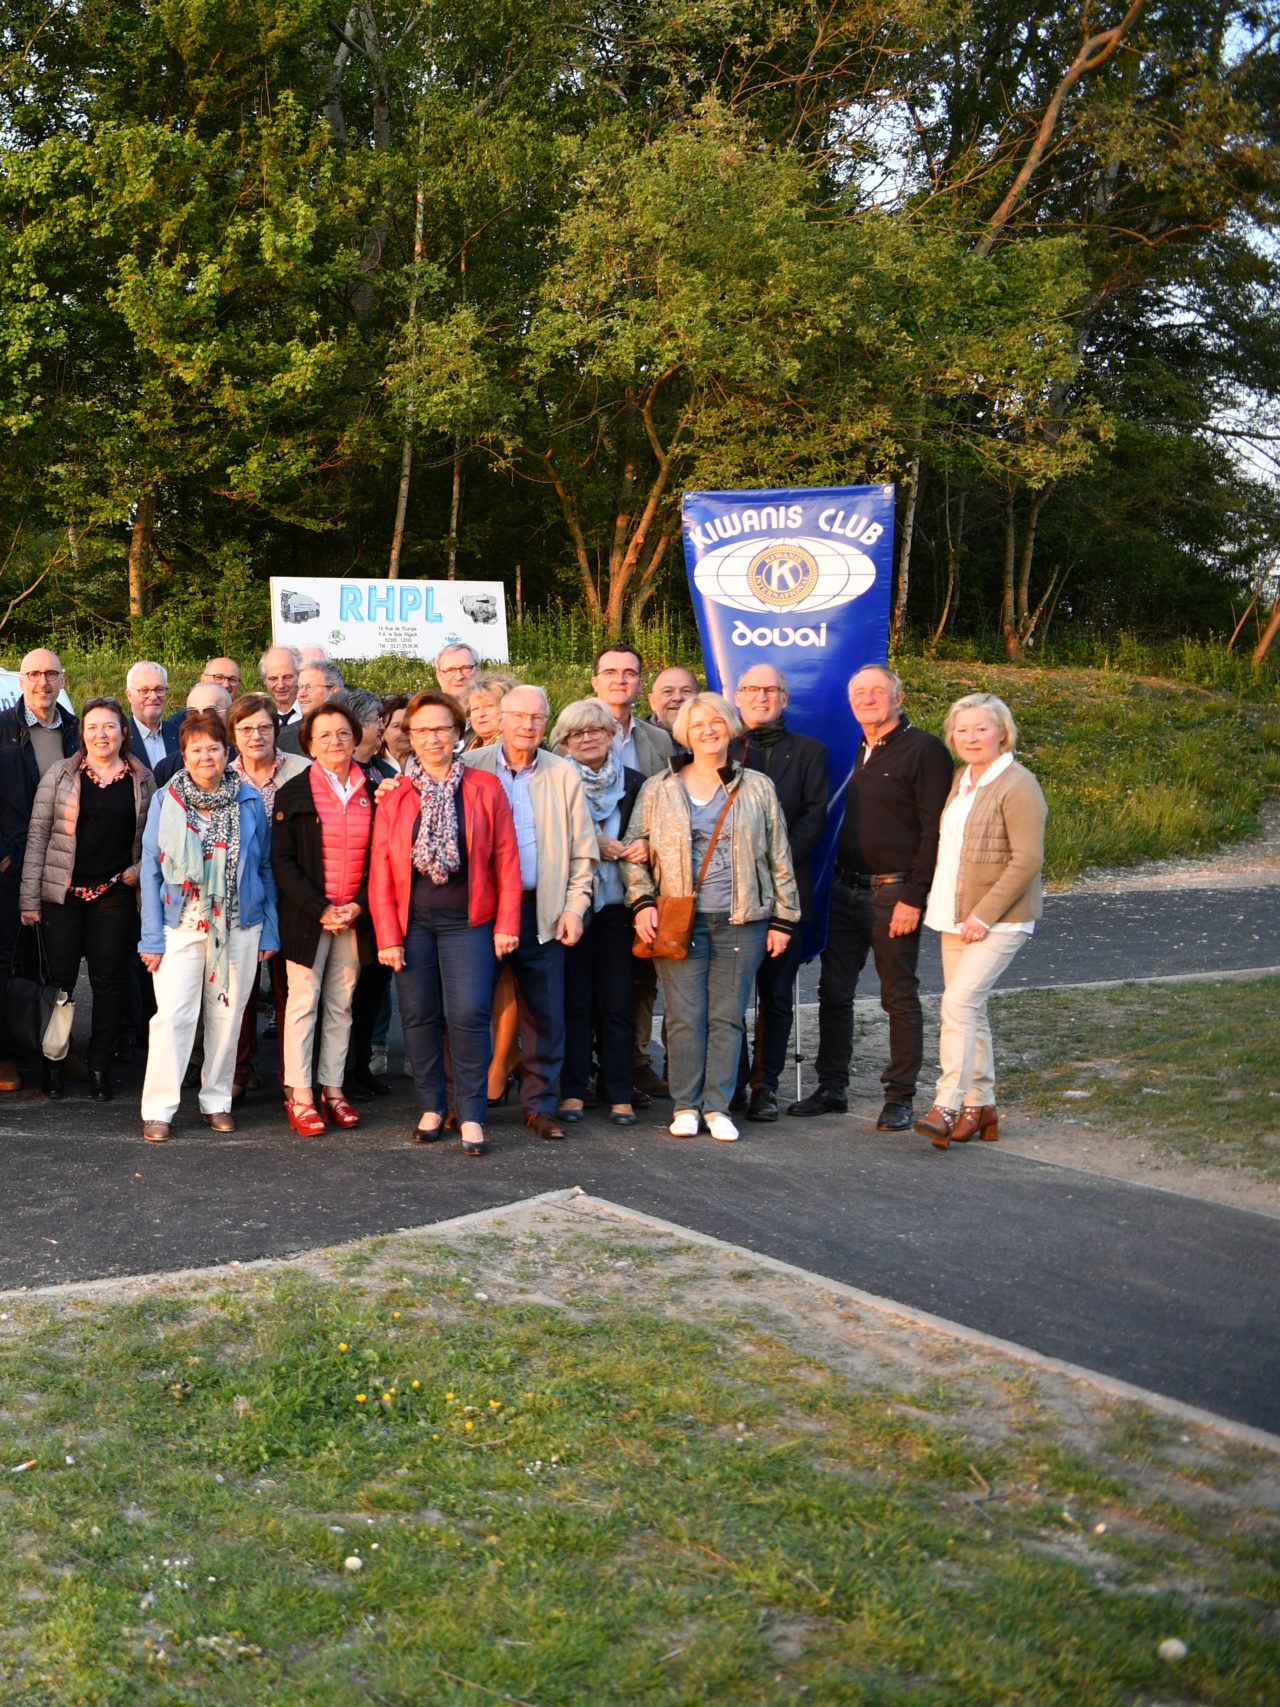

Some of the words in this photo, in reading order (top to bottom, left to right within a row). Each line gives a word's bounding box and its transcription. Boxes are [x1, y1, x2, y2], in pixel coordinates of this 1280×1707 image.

[689, 505, 803, 549] KIWANIS
[818, 508, 884, 545] CLUB
[771, 560, 796, 590] K
[339, 584, 443, 623] RHPL
